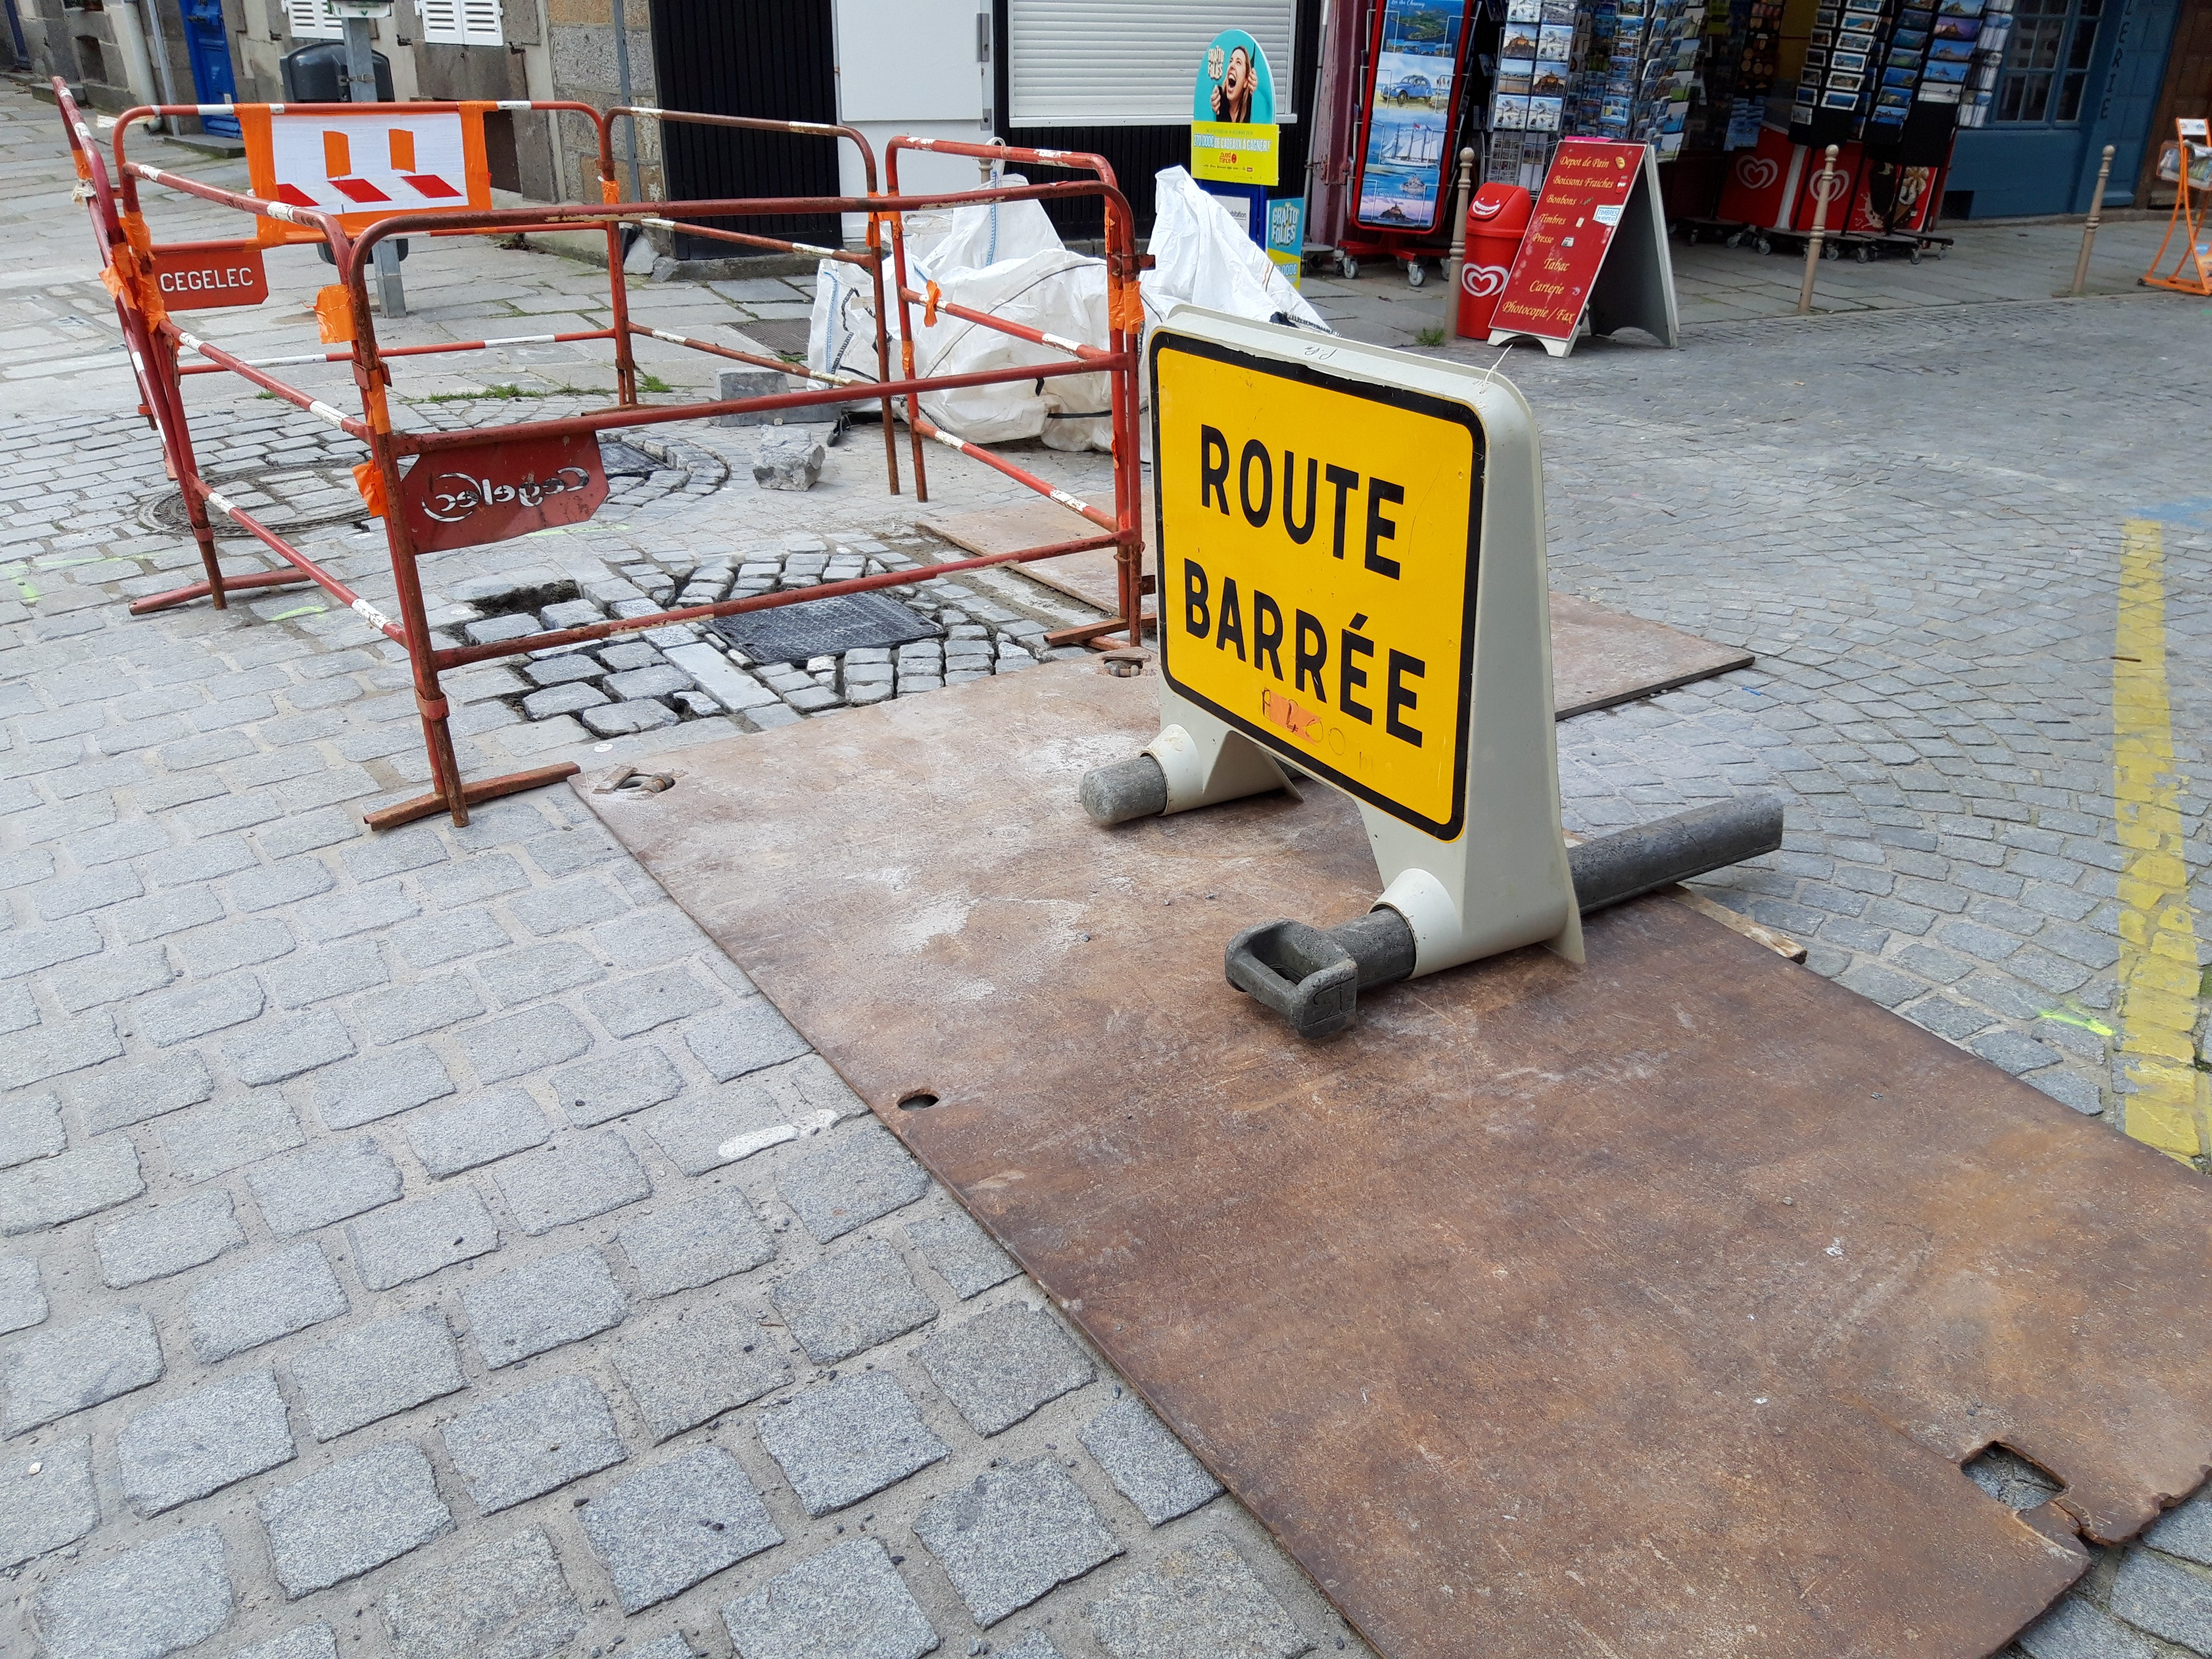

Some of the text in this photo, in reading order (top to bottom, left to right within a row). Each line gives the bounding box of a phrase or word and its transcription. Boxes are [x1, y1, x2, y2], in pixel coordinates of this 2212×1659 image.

[1560, 156, 1610, 169] Depot de Pain
[1553, 175, 1583, 186] Boissons
[1546, 194, 1577, 205] Bonbons
[1539, 214, 1566, 225] Timbres
[1532, 232, 1554, 243] Presse
[1544, 257, 1571, 272] Tabac
[160, 267, 254, 292] CEGELEC
[1529, 280, 1565, 294] Carterie
[1502, 300, 1550, 320] Photocopie
[1556, 309, 1576, 324] Fax
[1201, 424, 1405, 581] ROUTE
[1184, 557, 1425, 748] BARRÉE
